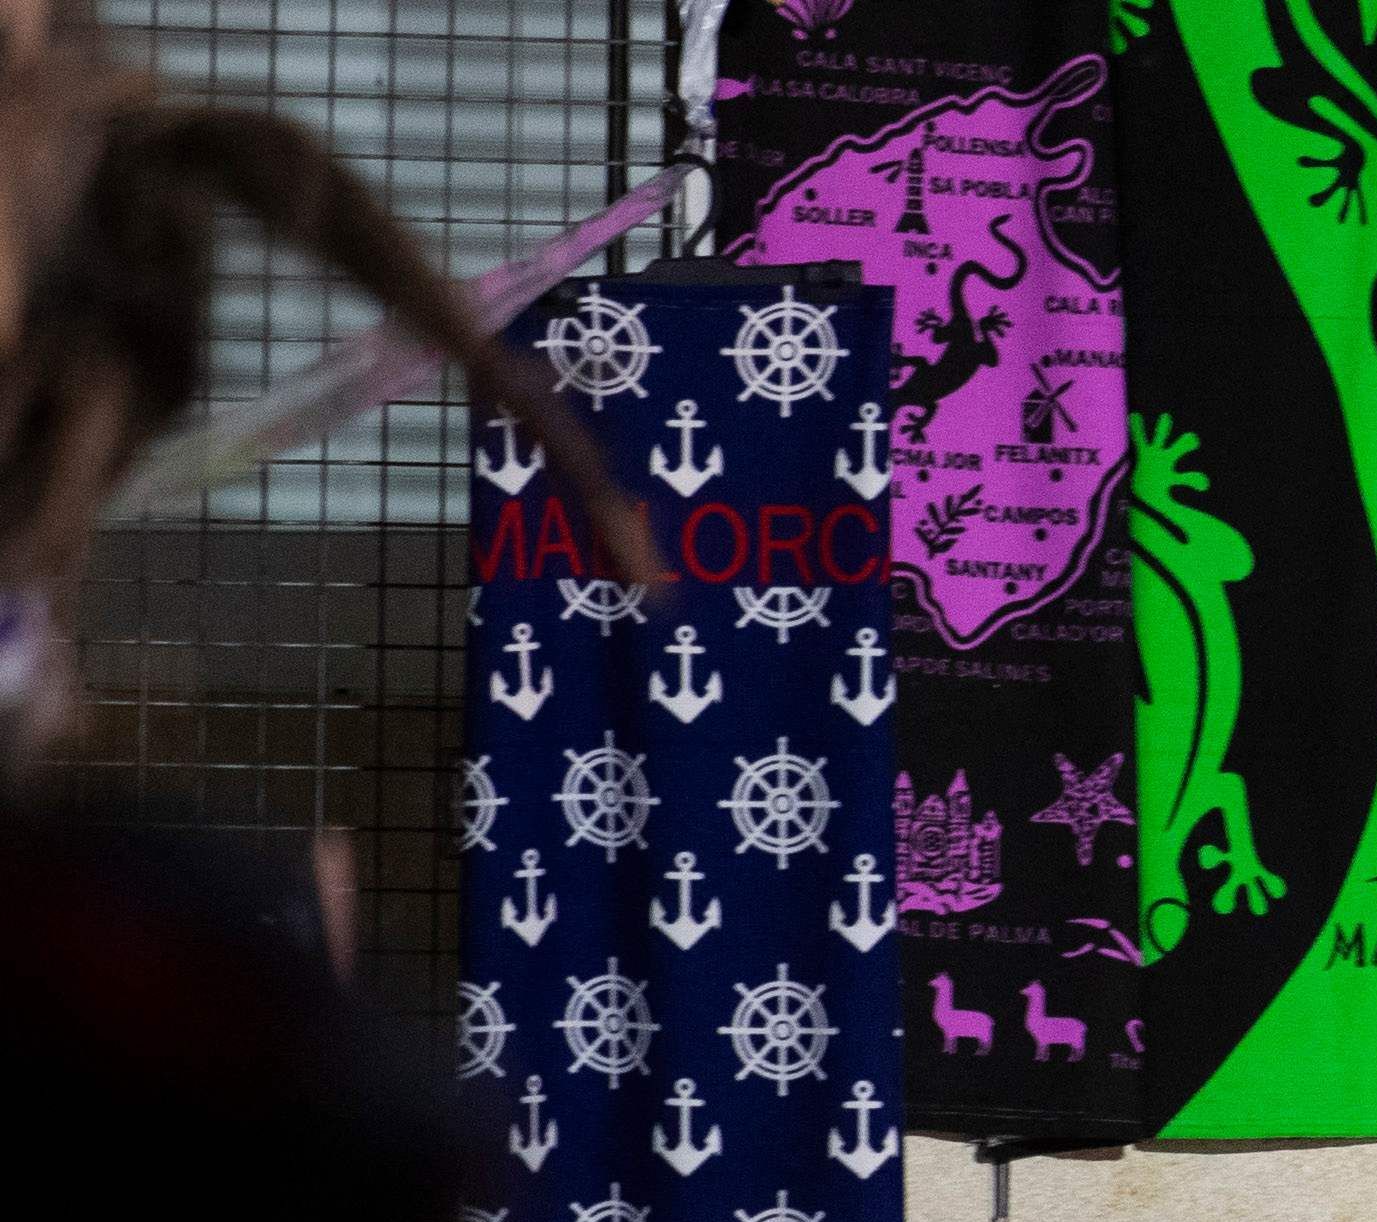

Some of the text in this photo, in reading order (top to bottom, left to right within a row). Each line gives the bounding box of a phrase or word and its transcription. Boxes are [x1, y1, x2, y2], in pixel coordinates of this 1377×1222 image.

[924, 134, 1028, 157] POLLENSA
[793, 205, 876, 227] SOLLER
[903, 239, 953, 260] INCA
[995, 445, 1100, 465] FELANITX
[984, 505, 1079, 526] CAMPOS
